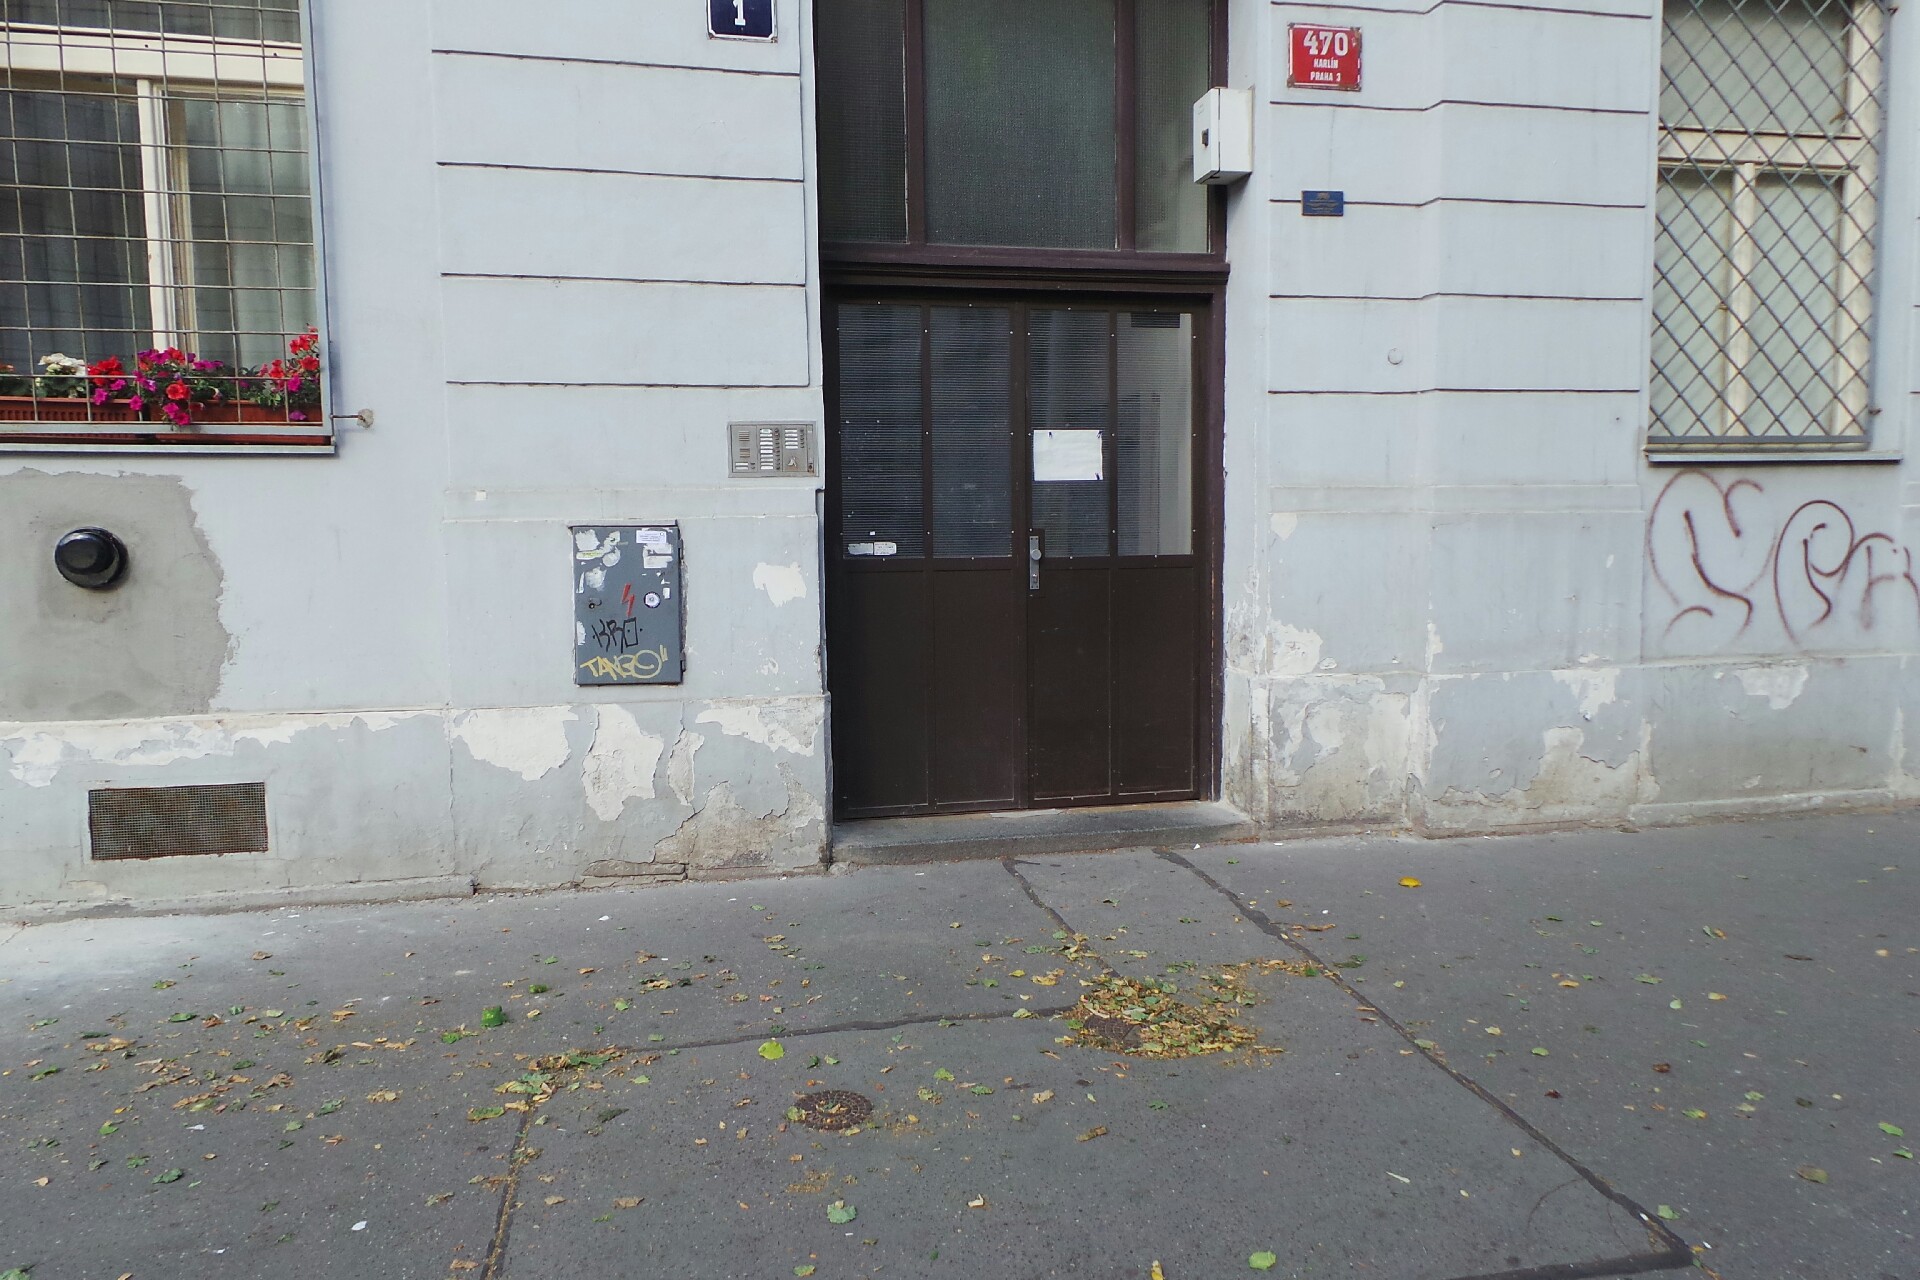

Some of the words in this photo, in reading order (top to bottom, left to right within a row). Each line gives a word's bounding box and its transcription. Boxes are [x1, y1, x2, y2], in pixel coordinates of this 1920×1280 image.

[732, 0, 746, 26] 1
[1303, 30, 1349, 57] 470
[1313, 57, 1339, 69] KARLÍN
[1310, 71, 1333, 81] PRAHA
[1336, 72, 1341, 82] 3
